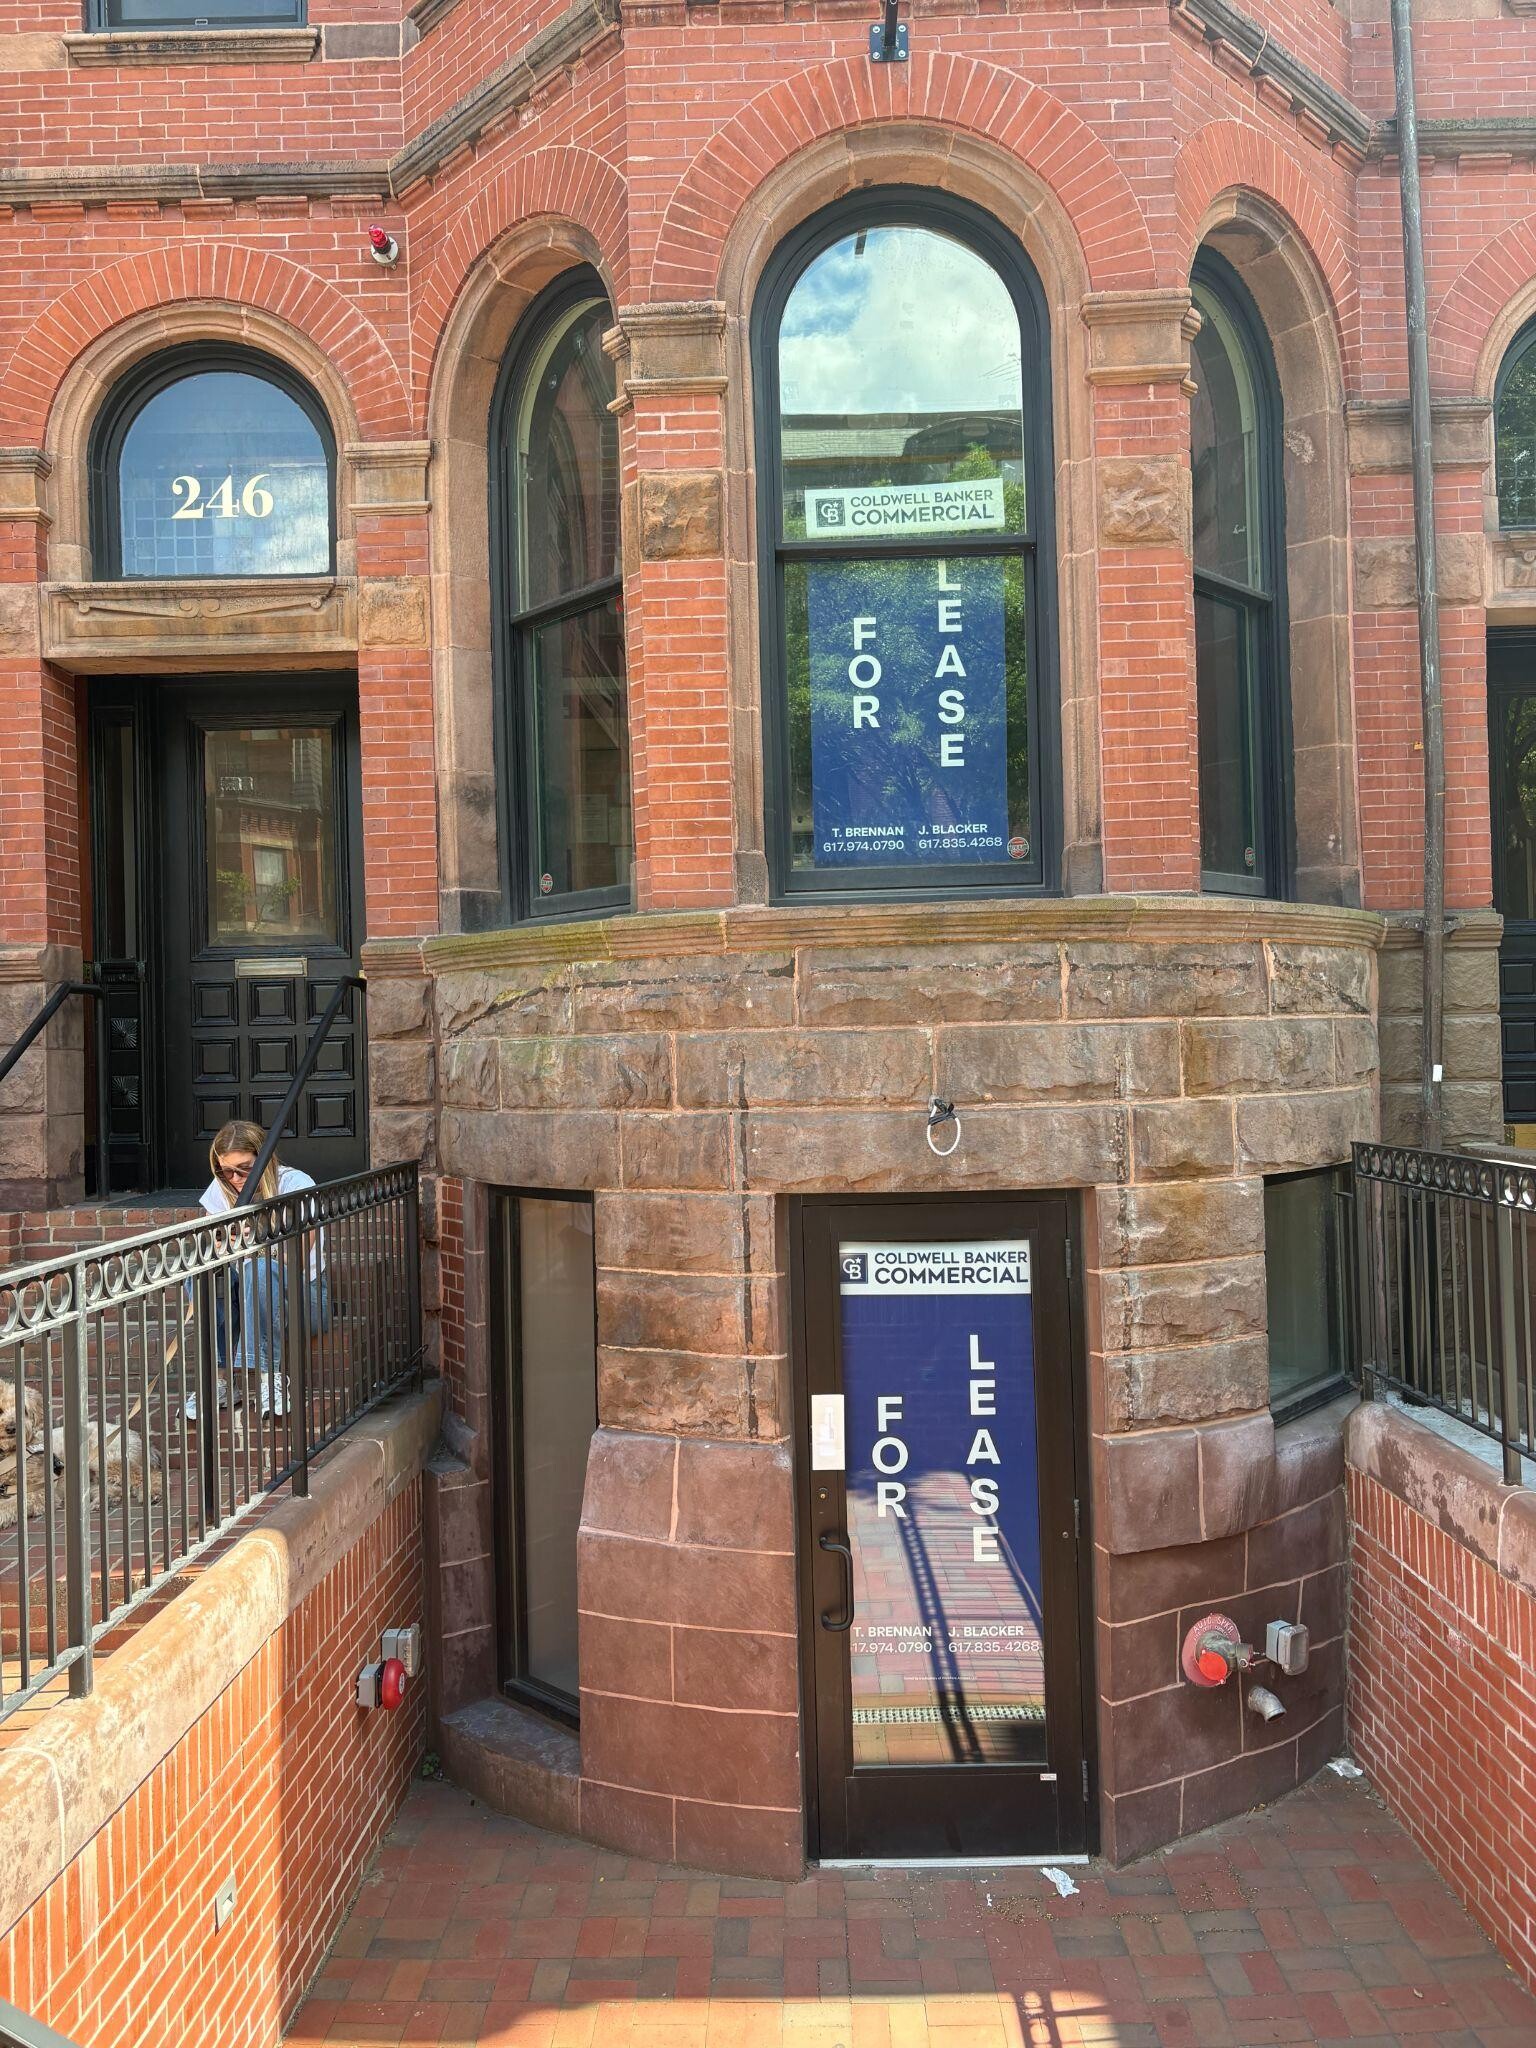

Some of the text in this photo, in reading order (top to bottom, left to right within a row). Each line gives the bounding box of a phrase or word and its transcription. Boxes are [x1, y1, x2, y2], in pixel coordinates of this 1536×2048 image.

[171, 474, 273, 518] 246
[850, 489, 993, 508] COLDWELL BANKER
[851, 504, 995, 525] COMMERCIAL
[847, 617, 882, 729] FOR
[934, 560, 967, 767] LEASE
[831, 823, 988, 838] T. BRENNAN J. BLACKER
[823, 840, 905, 852] 617.974.0790
[918, 837, 1003, 849] 617.835.4268
[874, 1251, 1028, 1265] COLDWELL BANKER
[874, 1266, 1029, 1285] COMMERCIAL
[871, 1396, 909, 1518] FOR
[966, 1334, 1001, 1563] LEASE
[853, 1625, 1024, 1637] T. BRENNAN J. BLACKER
[851, 1640, 1040, 1653] 17.974.0790 617.835.4268
